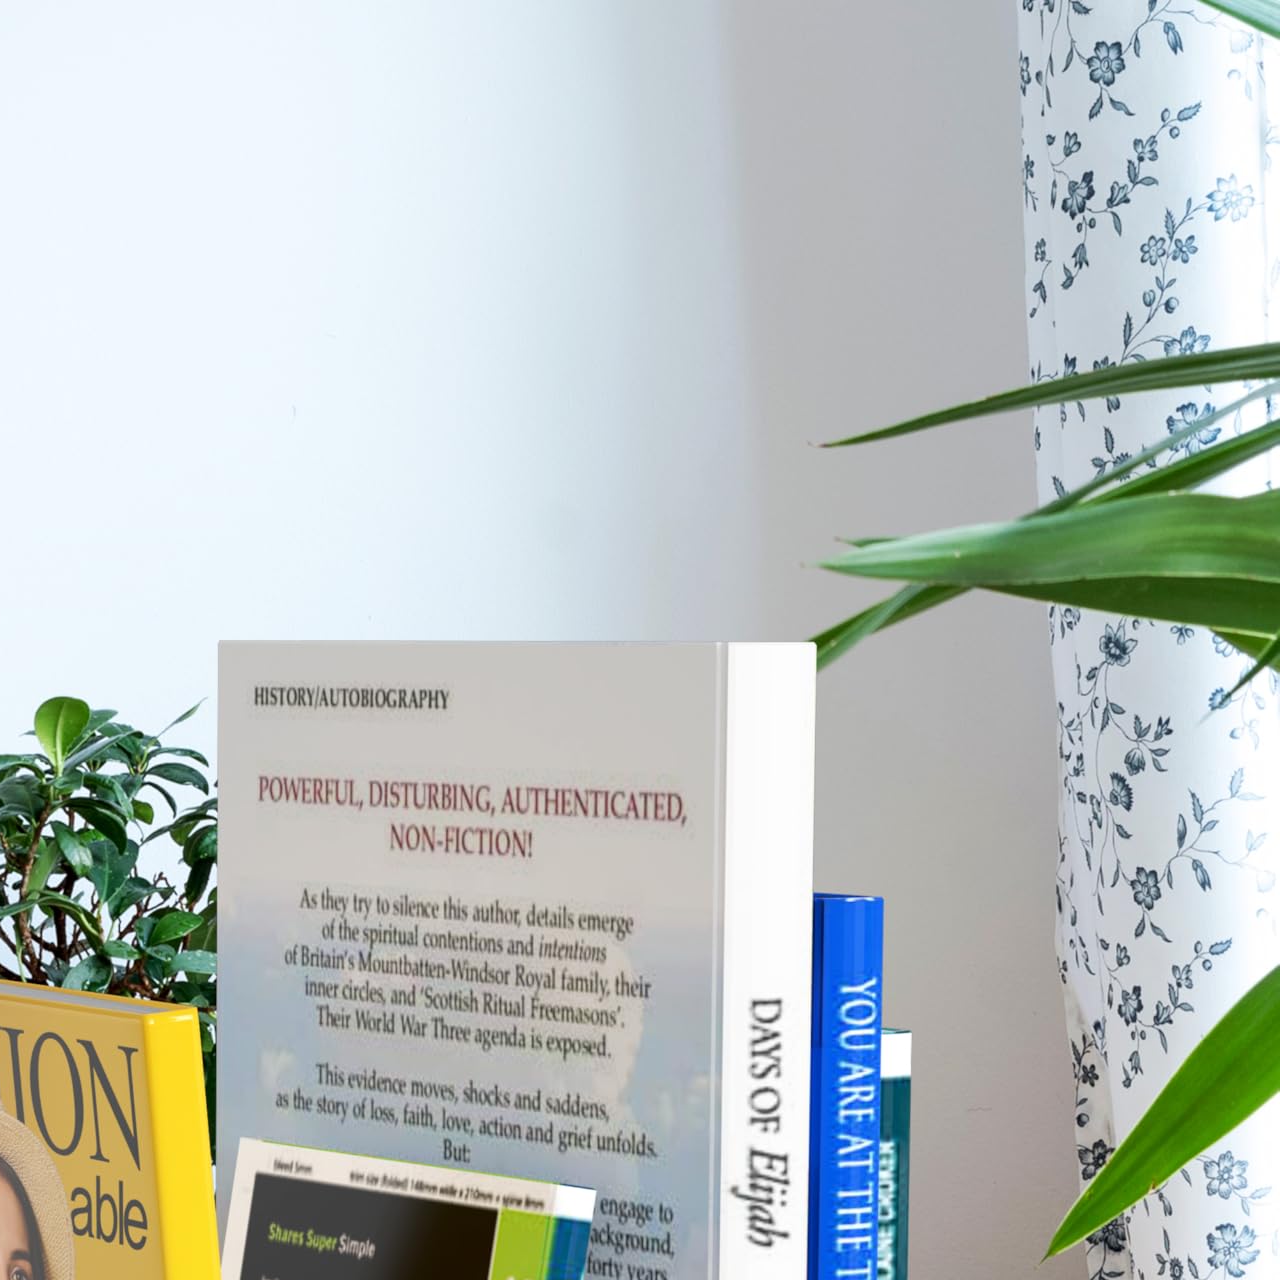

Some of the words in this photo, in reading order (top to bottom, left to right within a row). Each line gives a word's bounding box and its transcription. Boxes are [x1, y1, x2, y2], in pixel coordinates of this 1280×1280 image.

[254, 685, 450, 710] HISTORY/AUTOBIOGRAPHY
[258, 776, 364, 811] POWERFUL,
[369, 780, 496, 817] DISTURBING,
[501, 786, 688, 828] AUTHENTICATED,
[390, 823, 533, 858] NON-FICTION!
[300, 888, 318, 910] As
[321, 886, 349, 919] they
[353, 893, 372, 920] try
[377, 895, 390, 915] to
[393, 894, 440, 919] silence
[444, 895, 468, 921] this
[472, 900, 522, 929] author,
[526, 904, 574, 929] details
[578, 913, 634, 941] emerge
[322, 918, 335, 941] of
[339, 919, 359, 943] the
[363, 924, 419, 950] spiritual
[423, 929, 503, 956] contentions
[507, 933, 534, 957] and
[538, 934, 607, 964] intentions
[284, 944, 298, 966] of
[301, 945, 355, 971] Britain's
[358, 951, 510, 986] Mountbatten-Windsor
[515, 963, 556, 997] Royal
[561, 967, 611, 1002] family,
[615, 971, 652, 1001] their
[305, 976, 339, 998] inner
[342, 979, 386, 1005] circles,
[390, 984, 416, 1007] and
[483, 992, 525, 1018] Ritual
[316, 1004, 351, 1029] Their
[355, 1010, 395, 1034] World
[401, 1013, 427, 1037] War
[431, 1017, 471, 1043] Three
[475, 1025, 526, 1052] agenda
[531, 1028, 542, 1049] is
[546, 1034, 612, 1062] exposed.
[748, 997, 783, 1079] DAYS
[837, 976, 877, 1050] YOU
[316, 1062, 345, 1087] This
[348, 1069, 406, 1095] evidence
[411, 1082, 459, 1105] moves,
[463, 1079, 511, 1109] shocks
[514, 1088, 541, 1113] and
[545, 1093, 610, 1124] saddens,
[748, 1085, 782, 1135] OF
[836, 1060, 876, 1123] ARE
[276, 1091, 289, 1108] as
[293, 1088, 313, 1113] the
[316, 1095, 348, 1125] story
[353, 1098, 366, 1120] of
[370, 1098, 399, 1127] loss,
[403, 1102, 437, 1131] faith,
[442, 1107, 474, 1137] love,
[479, 1117, 521, 1140] action
[525, 1122, 554, 1145] and
[558, 1124, 594, 1154] grief
[597, 1130, 658, 1158] unfolds.
[836, 1132, 875, 1174] AT
[70, 1175, 149, 1251] able
[599, 1198, 654, 1228] engage
[659, 1203, 673, 1225] to
[730, 1146, 791, 1248] Elijah
[834, 1180, 874, 1254] THE
[268, 1221, 305, 1247] Shares
[306, 1228, 337, 1253] Super
[338, 1232, 376, 1260] Simple
[589, 1223, 675, 1260] ackground,
